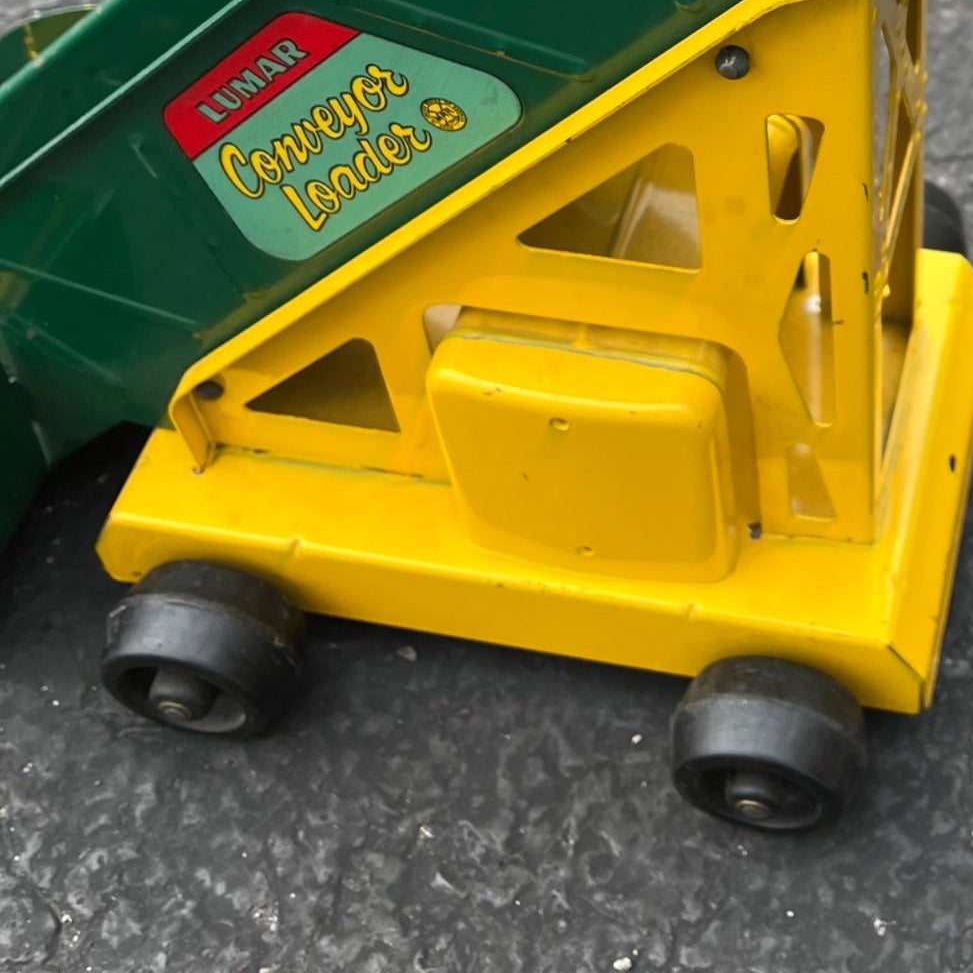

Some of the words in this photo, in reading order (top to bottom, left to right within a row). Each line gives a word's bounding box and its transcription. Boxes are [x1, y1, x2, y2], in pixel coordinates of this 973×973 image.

[196, 38, 309, 125] LUMAR
[219, 64, 410, 199] Conveyor
[281, 123, 432, 231] Loader
